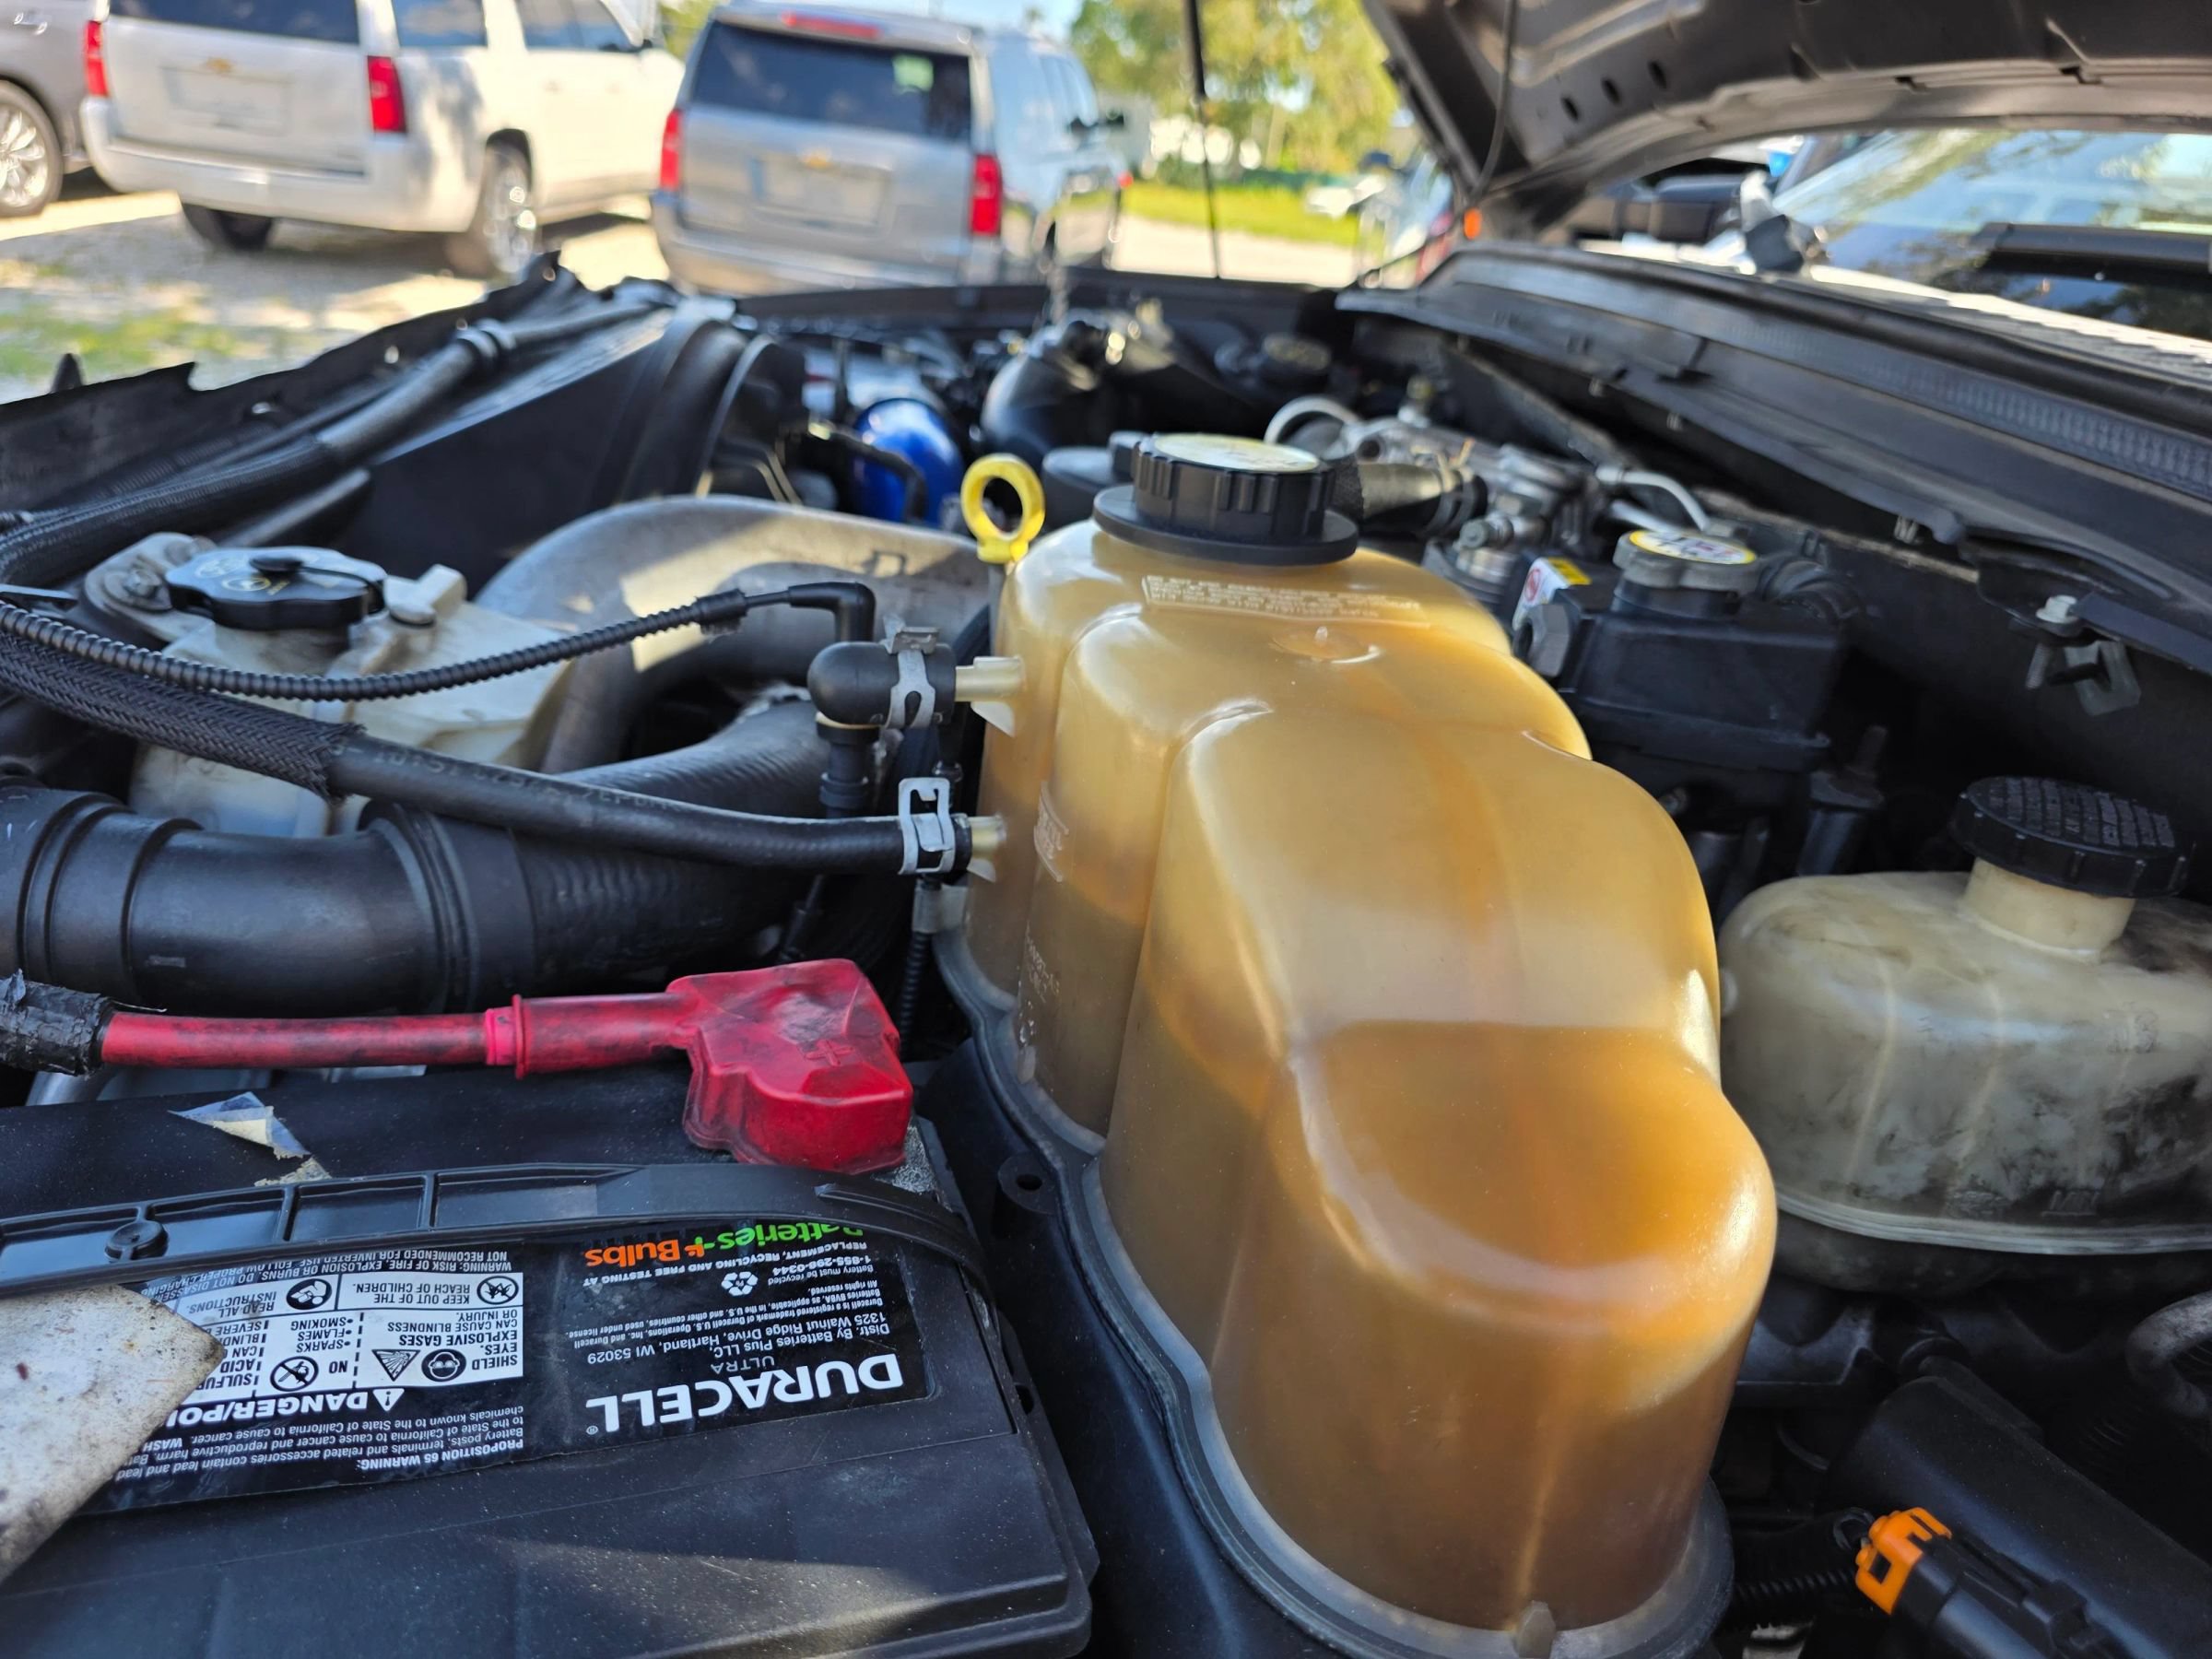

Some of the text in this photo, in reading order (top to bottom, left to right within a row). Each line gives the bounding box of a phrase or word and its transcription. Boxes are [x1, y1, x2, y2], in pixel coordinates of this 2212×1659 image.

[380, 1250, 401, 1259] FOR
[404, 1250, 484, 1261] RECOMMENDED
[487, 1251, 507, 1262] NOT
[584, 1239, 680, 1268] Bulbs
[302, 1265, 319, 1276] OR
[321, 1260, 382, 1274] EXPLOSION
[415, 1260, 429, 1270] OF
[432, 1261, 457, 1271] RISK
[459, 1261, 512, 1272] WARNING:
[582, 1241, 867, 1287] REPLACEMENT, RECYCLING AND FREE TESTING AT
[238, 1273, 254, 1285] DO
[258, 1267, 300, 1281] BURNS.
[767, 1264, 874, 1286] Battery must be recycled
[212, 1275, 236, 1288] NOT
[352, 1282, 470, 1294] REACH OF CHILDREN.
[807, 1279, 877, 1296] All rights reserved.
[373, 1293, 470, 1305] KEEP OUT OF THE
[846, 1288, 880, 1300] Batteries
[186, 1291, 276, 1314] INSTRUCTIONS.
[758, 1304, 767, 1313] in
[768, 1297, 810, 1312] applicable,
[795, 1301, 835, 1317] registered
[851, 1297, 883, 1309] Duracell
[218, 1301, 275, 1318] READ ALL
[455, 1309, 518, 1322] OR INJURY.
[709, 1309, 724, 1319] and
[726, 1307, 744, 1318] U.S.
[745, 1305, 758, 1316] the
[645, 1314, 686, 1327] countries,
[687, 1312, 707, 1322] other
[747, 1316, 755, 1325] of
[756, 1309, 795, 1324] trademark
[215, 1321, 262, 1336] SEVERE
[387, 1318, 518, 1333] CAN CAUSE BLINDNESS
[599, 1324, 623, 1335] under
[625, 1321, 644, 1331] used
[645, 1324, 691, 1337] Operations,
[693, 1322, 711, 1331] U.S.
[712, 1317, 746, 1331] Duracell
[398, 1329, 518, 1347] EXPLOSIVE GASES
[565, 1327, 598, 1338] license.
[586, 1312, 887, 1364] 1325 Walnut Ridge Drive, Hartland, WI 53029
[610, 1333, 626, 1344] and
[627, 1331, 643, 1340] Inc.
[574, 1335, 608, 1349] Duracell
[709, 1323, 890, 1358] Distr. By Batteries Plus LLC,
[232, 1346, 257, 1358] CAN
[479, 1342, 518, 1355] EYES.
[219, 1359, 255, 1373] ACID
[328, 1360, 348, 1373] NO
[472, 1355, 518, 1371] SHIELD
[710, 1355, 775, 1374] ULTRA
[461, 1421, 489, 1434] State
[492, 1418, 510, 1430] the
[512, 1416, 524, 1426] to
[142, 1405, 524, 1452] chemicals known to the State of California to cause cancer. WASH
[390, 1428, 444, 1441] California
[446, 1425, 458, 1436] of
[271, 1438, 294, 1450] and
[295, 1435, 336, 1448] cancer
[339, 1433, 373, 1445] cause
[374, 1432, 388, 1443] to
[114, 1427, 524, 1482] Battery posts, terminals and related accessories contain lead and lead
[192, 1439, 268, 1458] reproductive
[356, 1438, 524, 1470] PROPOSITION 65 WARNING:
[154, 1449, 189, 1462] harm.
